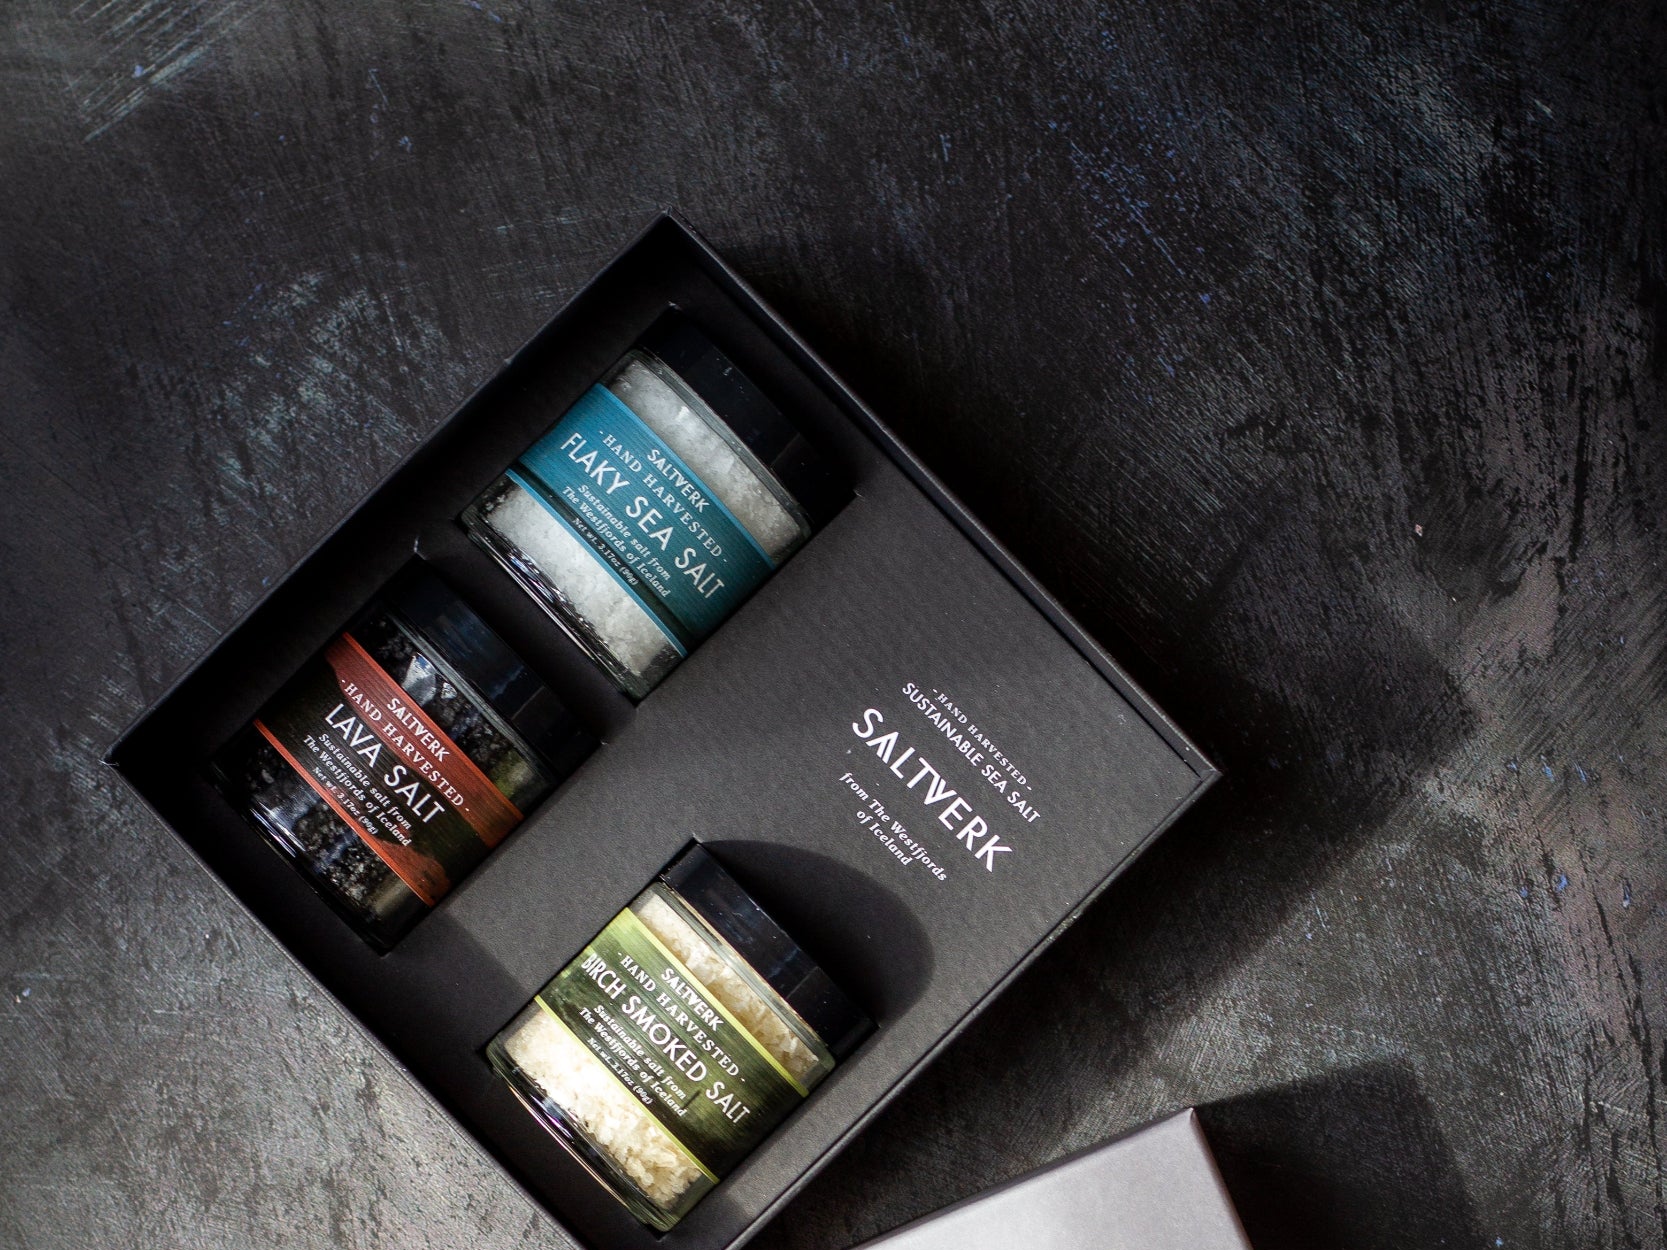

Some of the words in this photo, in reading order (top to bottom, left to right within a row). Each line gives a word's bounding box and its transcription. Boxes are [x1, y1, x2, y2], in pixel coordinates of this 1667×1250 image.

[560, 432, 630, 495] FLAKY
[625, 496, 674, 551] SEA
[674, 547, 725, 599] SALT
[578, 484, 631, 538] Sustainable
[630, 535, 650, 558] salt
[649, 557, 671, 580] from
[602, 434, 642, 472] HAND
[643, 474, 723, 557] HARVESTED
[647, 449, 710, 513] SALTVERK
[562, 486, 578, 504] The
[579, 504, 626, 552] Westfjords
[626, 552, 637, 564] of
[637, 562, 671, 598] Iceland
[318, 733, 370, 787] Sustainable
[370, 787, 390, 808] salt
[387, 806, 412, 830] from
[325, 703, 382, 768] LAVA
[384, 765, 445, 823] SALT
[344, 683, 382, 721] HAND
[383, 723, 464, 806] HARVESTED
[387, 698, 450, 762] SALTVERK
[902, 682, 984, 766] SUSTAINABLE
[981, 765, 1008, 794] SEA
[1007, 791, 1040, 823] SALT
[937, 693, 968, 724] HAND
[967, 724, 1027, 786] HARVESTED
[303, 735, 319, 752] The
[319, 751, 366, 801] Westfjords
[366, 798, 378, 813] of
[376, 812, 412, 847] Iceland
[839, 772, 869, 802] from
[869, 798, 890, 822] The
[890, 821, 947, 881] Westfjords
[852, 708, 1013, 873] SALTVERK
[856, 811, 873, 824] of
[868, 822, 913, 866] Iceland
[581, 953, 626, 1000] BIRCH
[622, 995, 707, 1082] SMOKED
[706, 1081, 750, 1124] SALT
[593, 1005, 645, 1056] Sustainable
[644, 1055, 665, 1077] salt
[663, 1075, 686, 1100] from
[620, 955, 656, 992] HAND
[656, 992, 739, 1076] HARVESTED
[661, 967, 724, 1032] SALTVERK
[579, 1007, 594, 1025] The
[594, 1022, 641, 1071] Westfjords
[640, 1071, 651, 1083] of
[651, 1081, 687, 1117] Iceland
